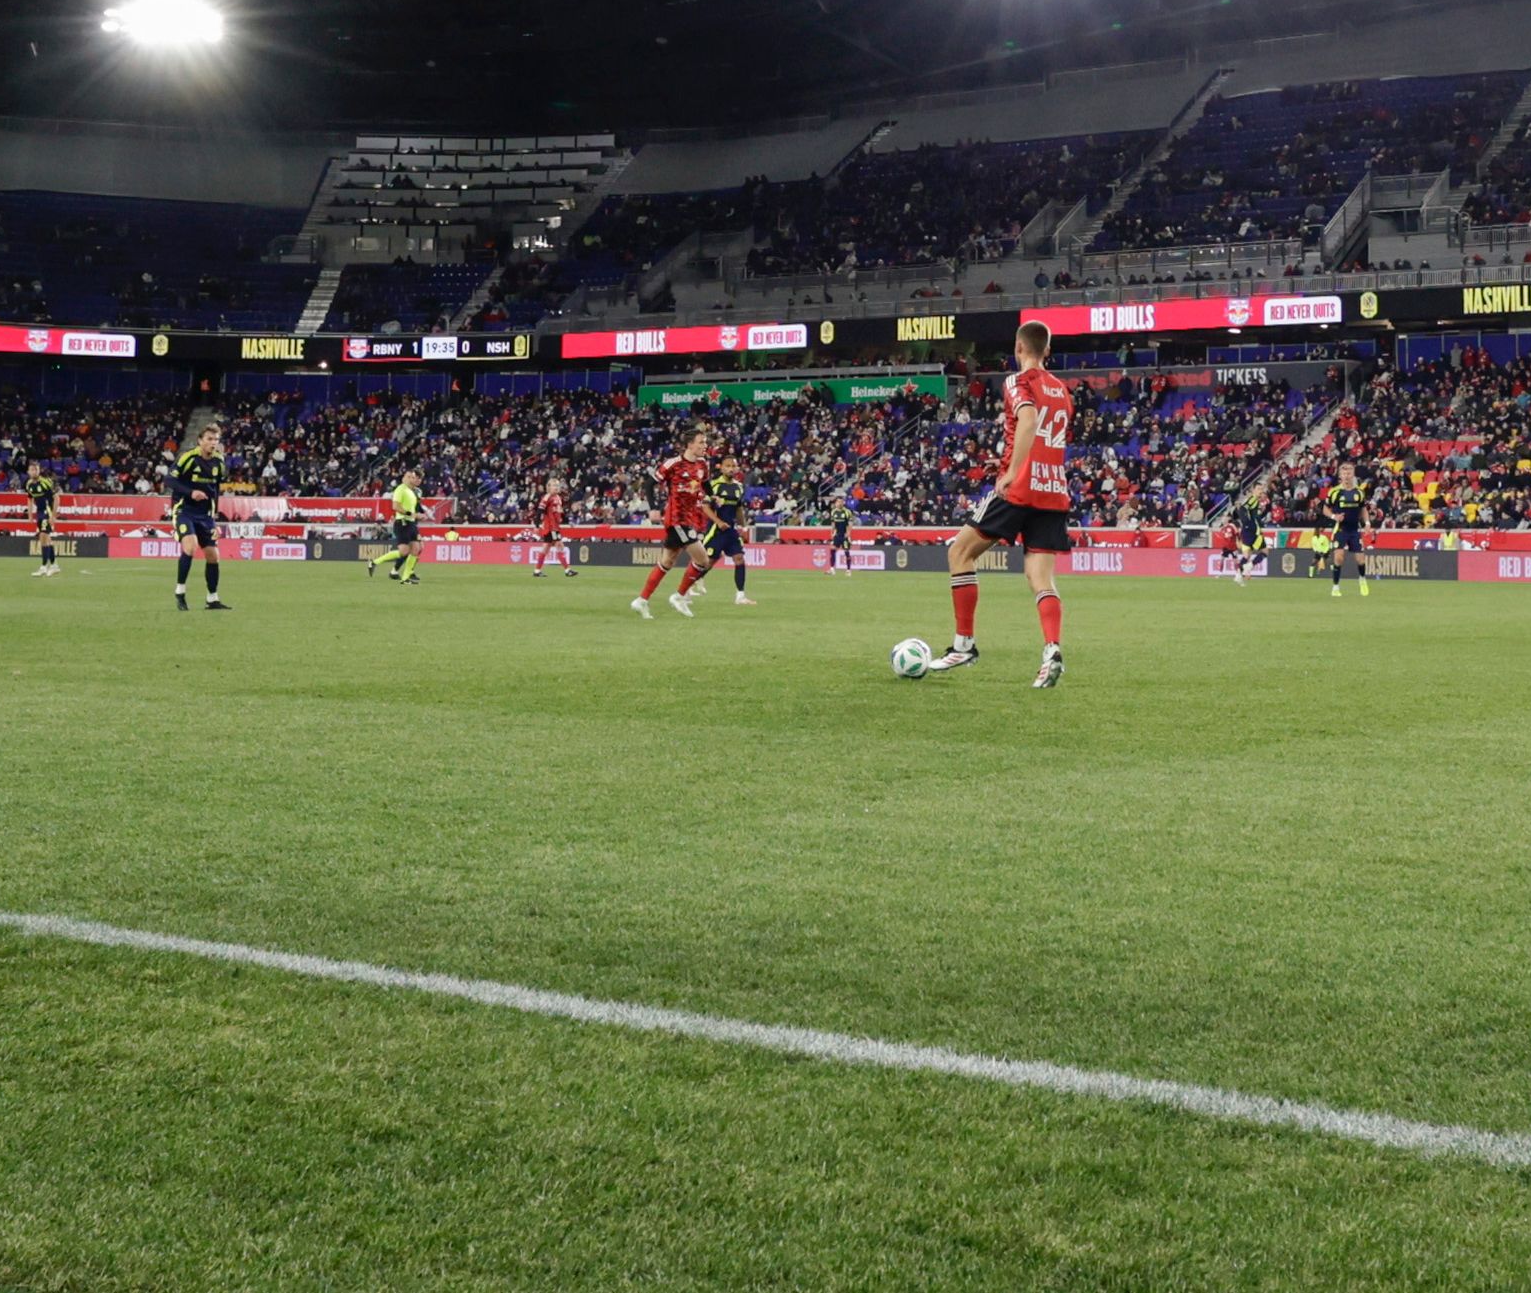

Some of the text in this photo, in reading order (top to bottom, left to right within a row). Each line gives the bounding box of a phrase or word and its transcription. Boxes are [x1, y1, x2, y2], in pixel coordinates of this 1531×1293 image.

[1090, 304, 1155, 332] RED BULLS
[1270, 302, 1335, 320] RED NEVER QUITS
[752, 327, 802, 345] RED NEVER QUITS
[897, 315, 955, 341] NASHVILLE
[68, 338, 130, 352] RED NEVER QUITS
[241, 337, 304, 360] NASHVILLE
[372, 341, 510, 355] RBNY 1 19:35 0 NSH
[615, 330, 665, 354] RED BULLS
[1216, 368, 1267, 386] TICKETS
[662, 390, 705, 404] Heineken
[754, 388, 799, 401] Heineken
[851, 385, 898, 399] Heineken
[1035, 406, 1068, 448] 42
[1051, 465, 1066, 480] YO
[1030, 477, 1068, 494] Red Bu
[92, 506, 134, 515] STADIUM
[29, 540, 77, 556] NAVILLE
[140, 541, 181, 556] RED BULL
[976, 550, 1008, 570] HVILLE
[1072, 552, 1123, 572] RED BULLS
[1498, 557, 1522, 578] RED
